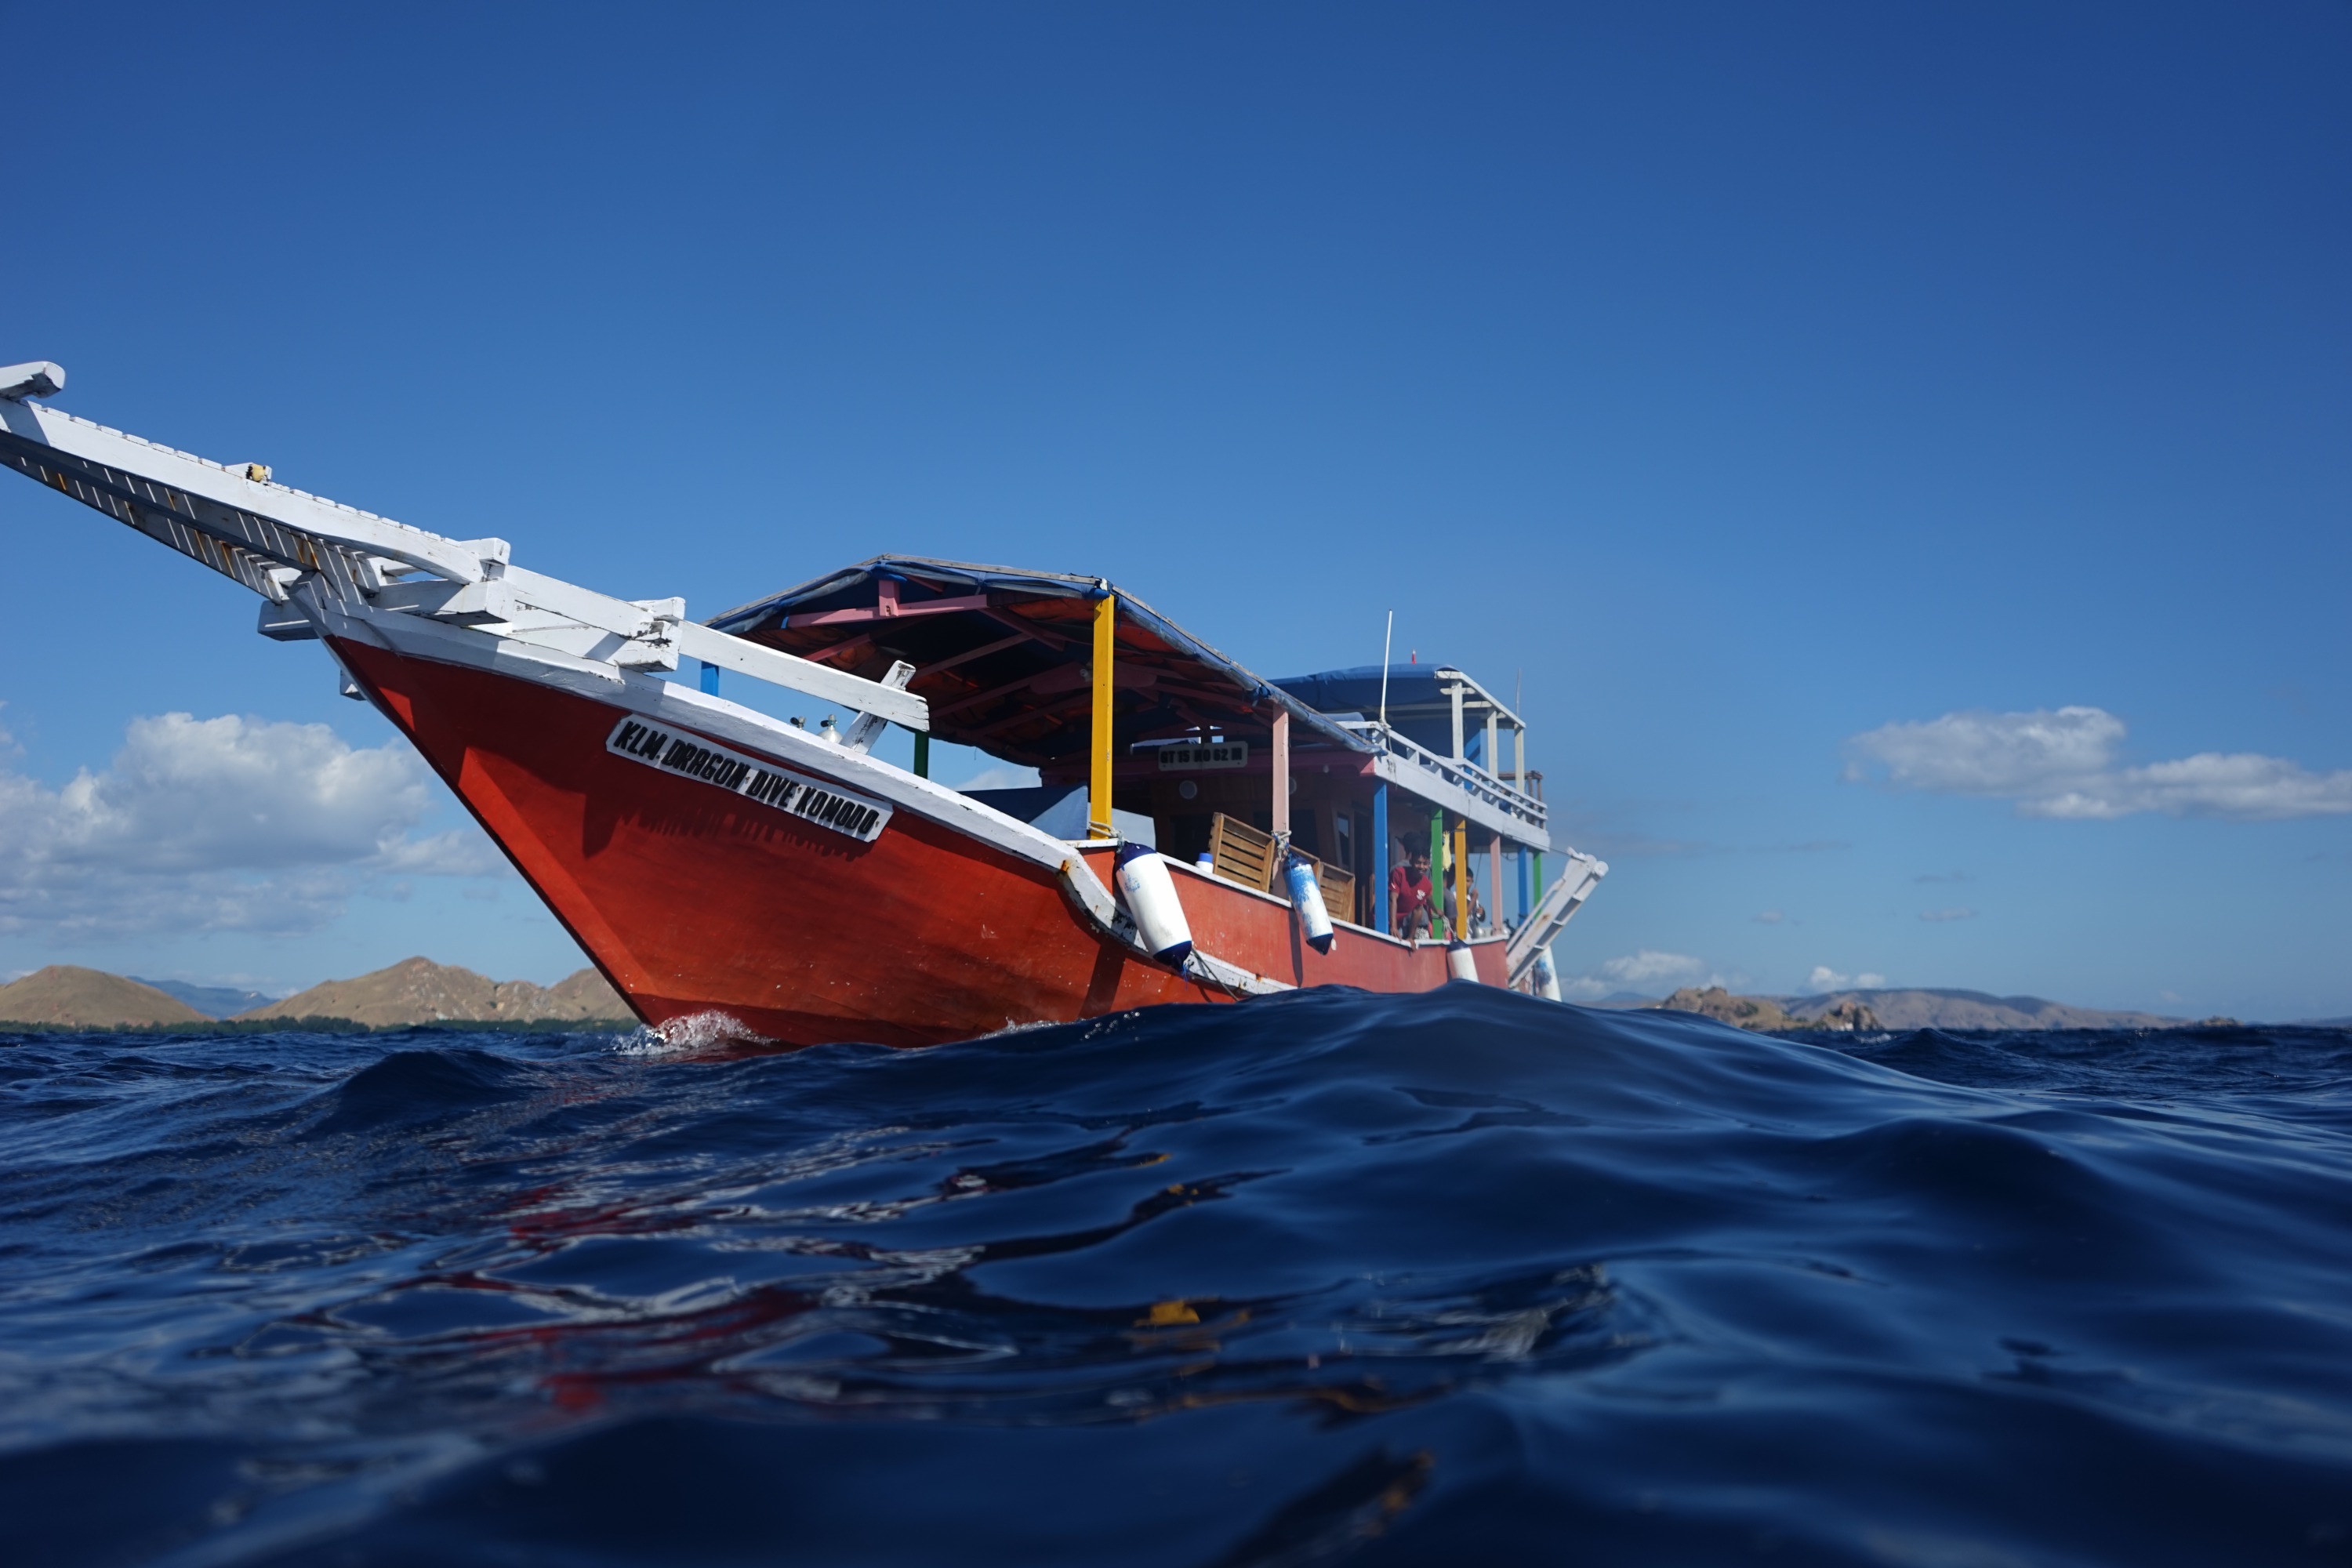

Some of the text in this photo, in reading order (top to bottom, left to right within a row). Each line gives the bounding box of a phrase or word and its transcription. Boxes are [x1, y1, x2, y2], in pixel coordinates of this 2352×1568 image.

[1160, 750, 1175, 764] GT
[1178, 750, 1190, 763] 15
[1213, 748, 1229, 761] 62
[661, 739, 752, 789] DRAGON
[746, 768, 800, 808] DIVE
[794, 786, 880, 834] KOMODO
